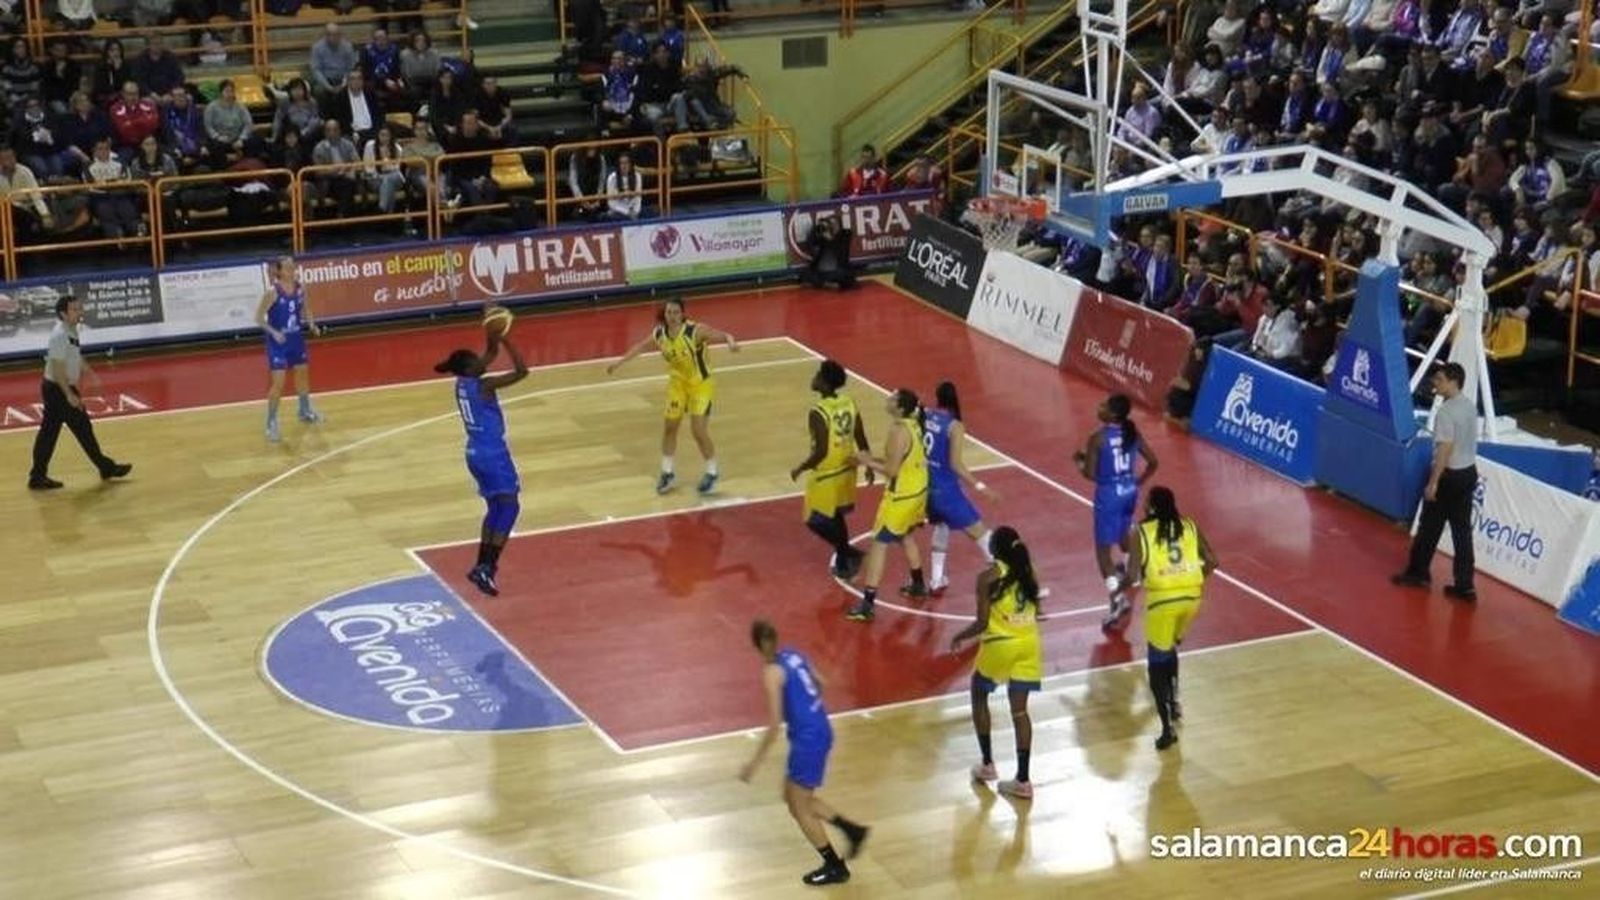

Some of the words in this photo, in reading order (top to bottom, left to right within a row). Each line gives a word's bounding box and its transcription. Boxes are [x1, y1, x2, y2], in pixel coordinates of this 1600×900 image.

[362, 261, 383, 277] en
[386, 255, 401, 274] el
[404, 252, 464, 273] campo
[545, 269, 613, 287] fertilizantes
